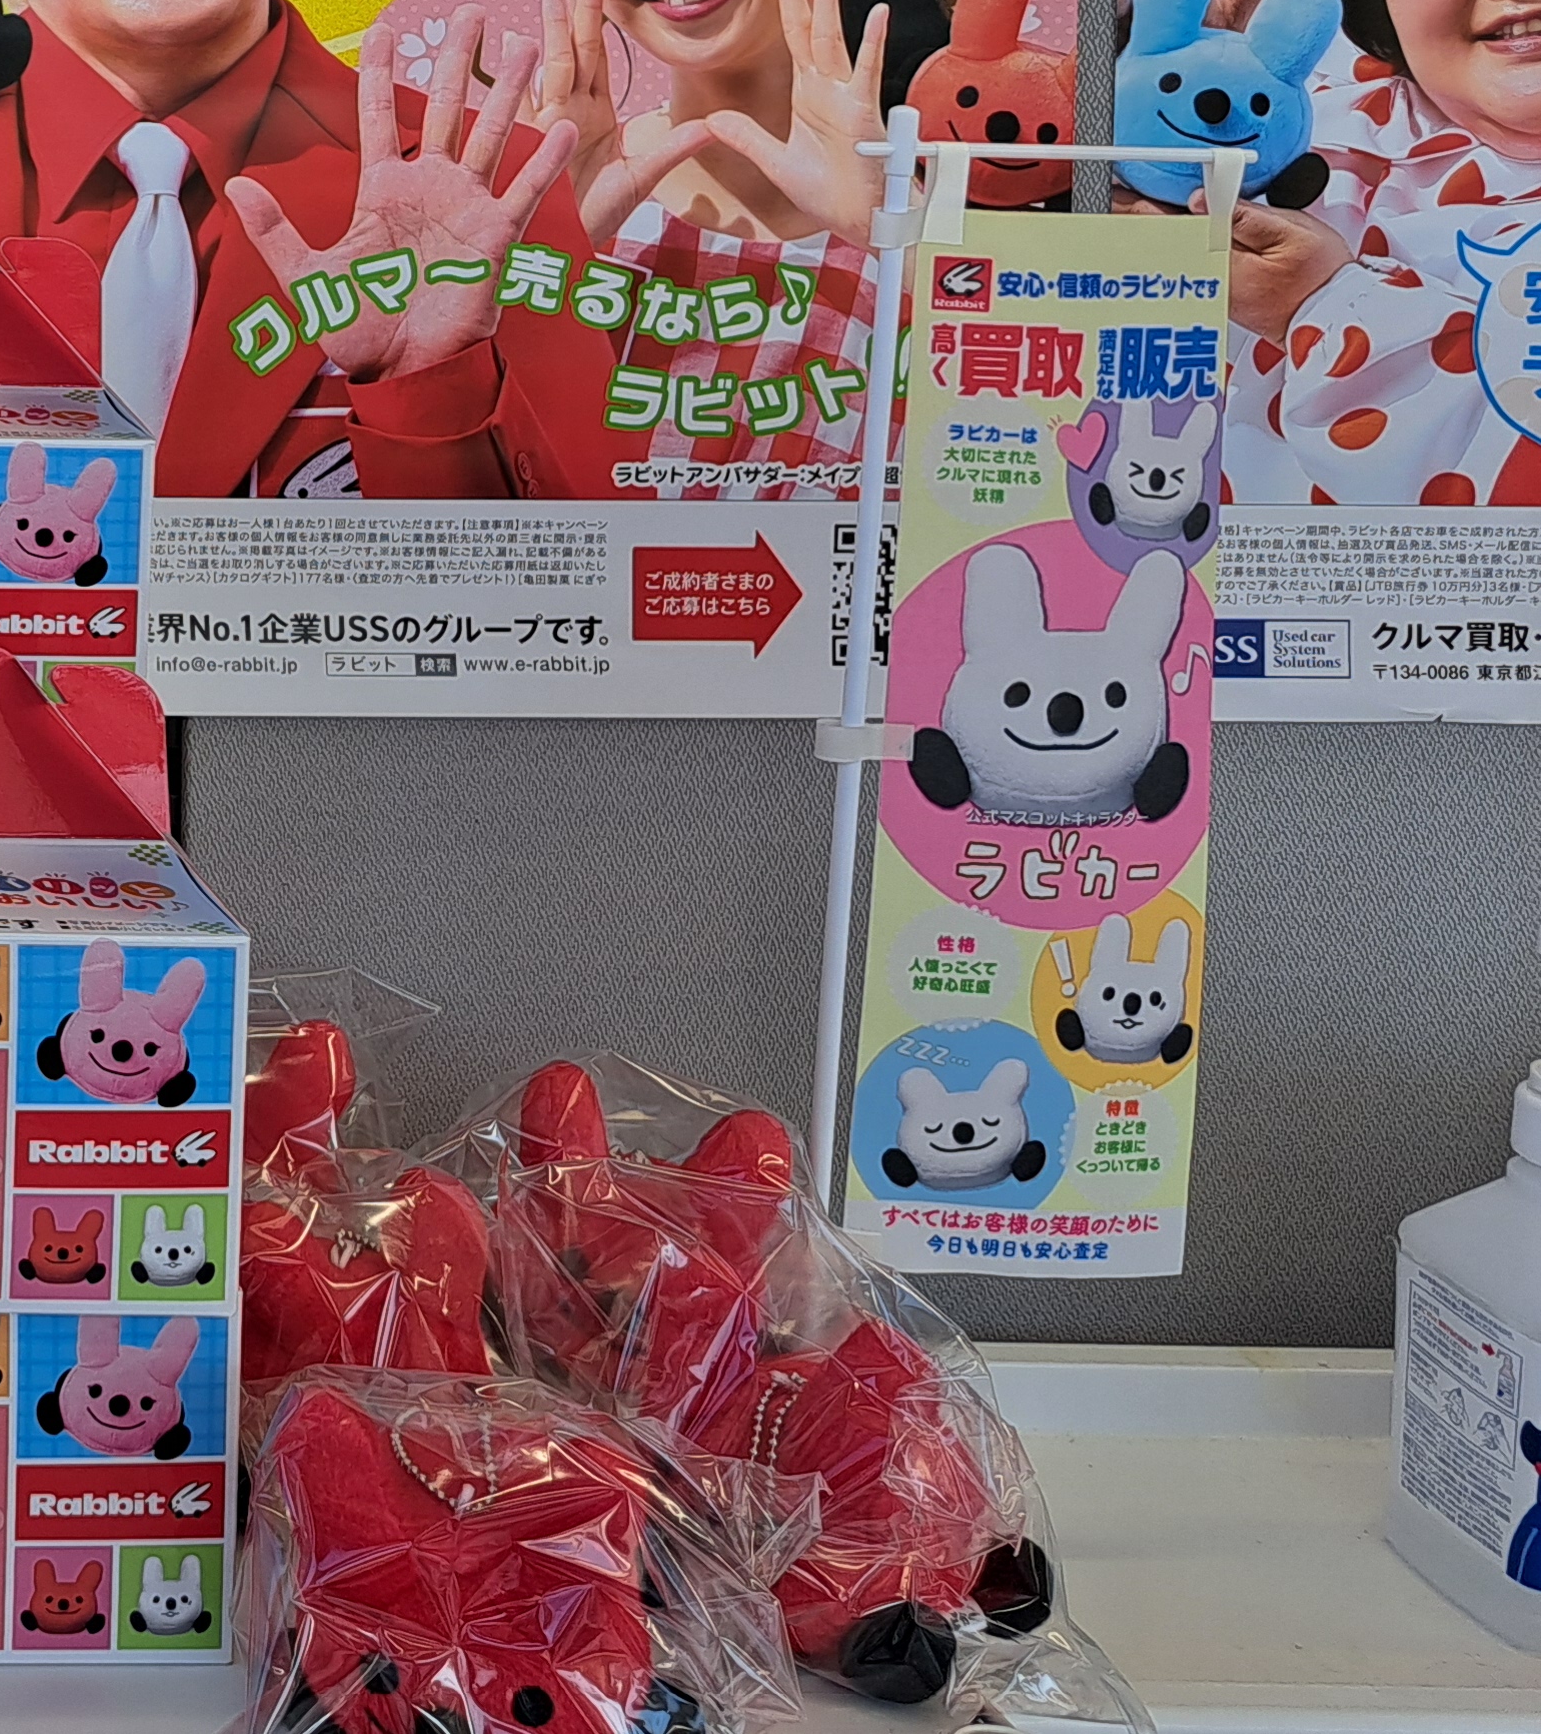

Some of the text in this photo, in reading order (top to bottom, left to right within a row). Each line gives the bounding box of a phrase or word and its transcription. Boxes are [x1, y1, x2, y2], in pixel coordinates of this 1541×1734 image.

[934, 272, 1220, 310] Rabbit 安心・信頼のラビットです
[960, 326, 1219, 399] 買取 販売
[609, 364, 907, 434] ラビット
[948, 424, 1038, 443] ラビカーは
[943, 448, 1038, 466] 大切にされた
[644, 571, 775, 592] ご成約者さまの
[645, 596, 771, 617] ご応募はこちら
[1273, 630, 1335, 642] Used car
[1273, 644, 1325, 655] System
[331, 657, 397, 671] ラビット
[420, 657, 454, 674] 検索
[464, 657, 610, 675] www.e-rabbit.jp
[1273, 657, 1341, 669] Solutions
[956, 830, 1158, 900] ラビカー
[937, 935, 975, 954] 性格
[28, 1138, 169, 1166] Rabbit
[881, 1206, 1159, 1235] すべてはお客様の笑顔のために
[927, 1235, 1109, 1259] 今日も明日も安心査定
[28, 1491, 166, 1518] Rabbit
